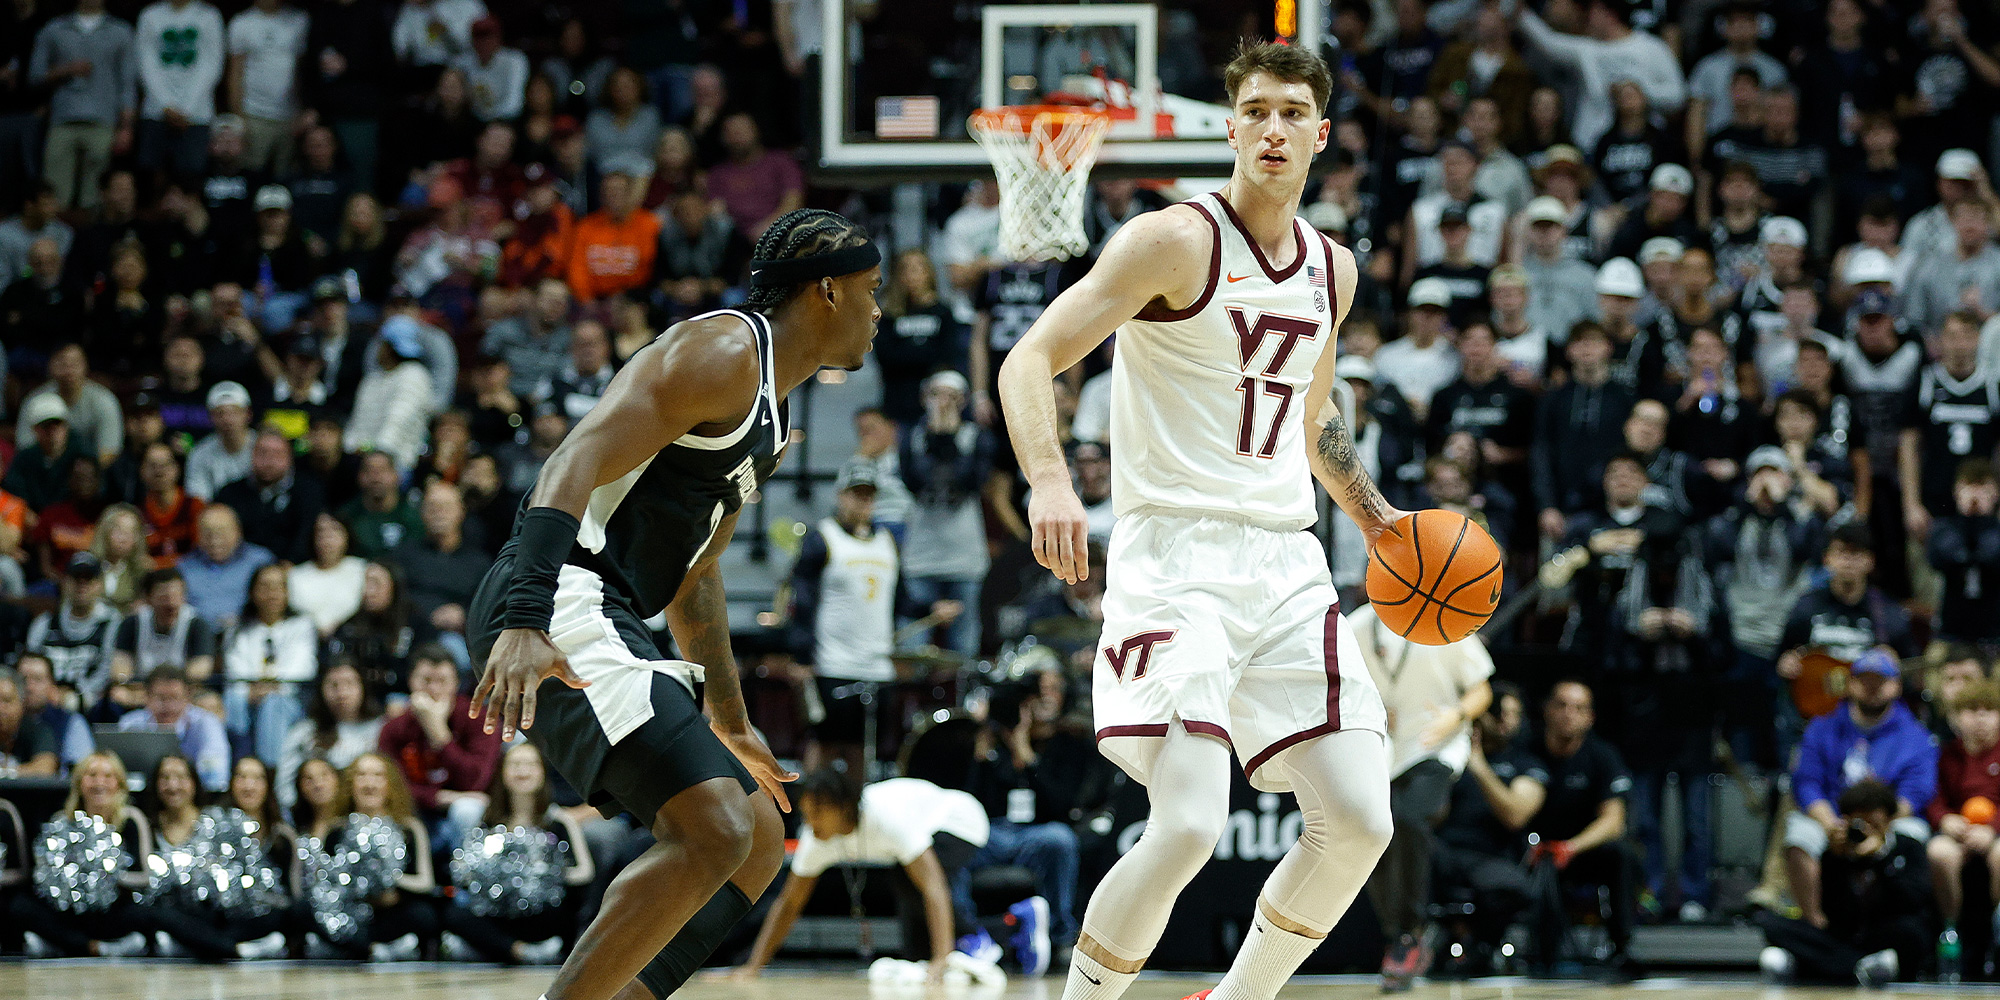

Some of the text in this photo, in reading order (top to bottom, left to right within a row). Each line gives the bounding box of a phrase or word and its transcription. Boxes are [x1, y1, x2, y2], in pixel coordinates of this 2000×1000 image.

[1225, 306, 1322, 378] VT
[1235, 375, 1295, 459] 17
[1102, 629, 1179, 684] VT
